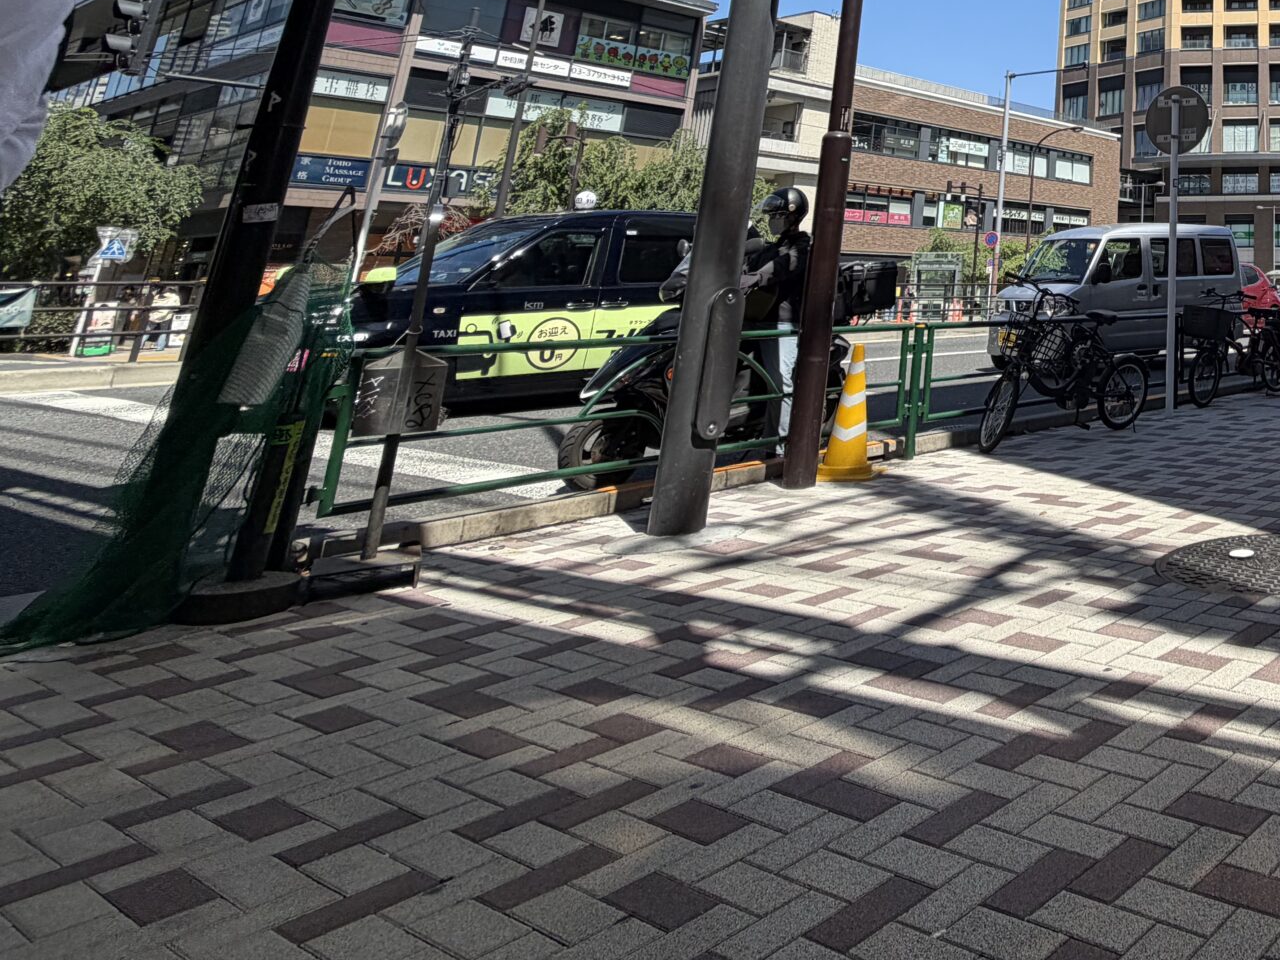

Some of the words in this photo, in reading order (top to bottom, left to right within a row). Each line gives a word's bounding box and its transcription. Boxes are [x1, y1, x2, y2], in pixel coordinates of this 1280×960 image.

[324, 166, 364, 176] MASSAGE
[321, 174, 352, 184] GROUP
[432, 329, 457, 338] TAXI
[537, 326, 569, 338] お迎え
